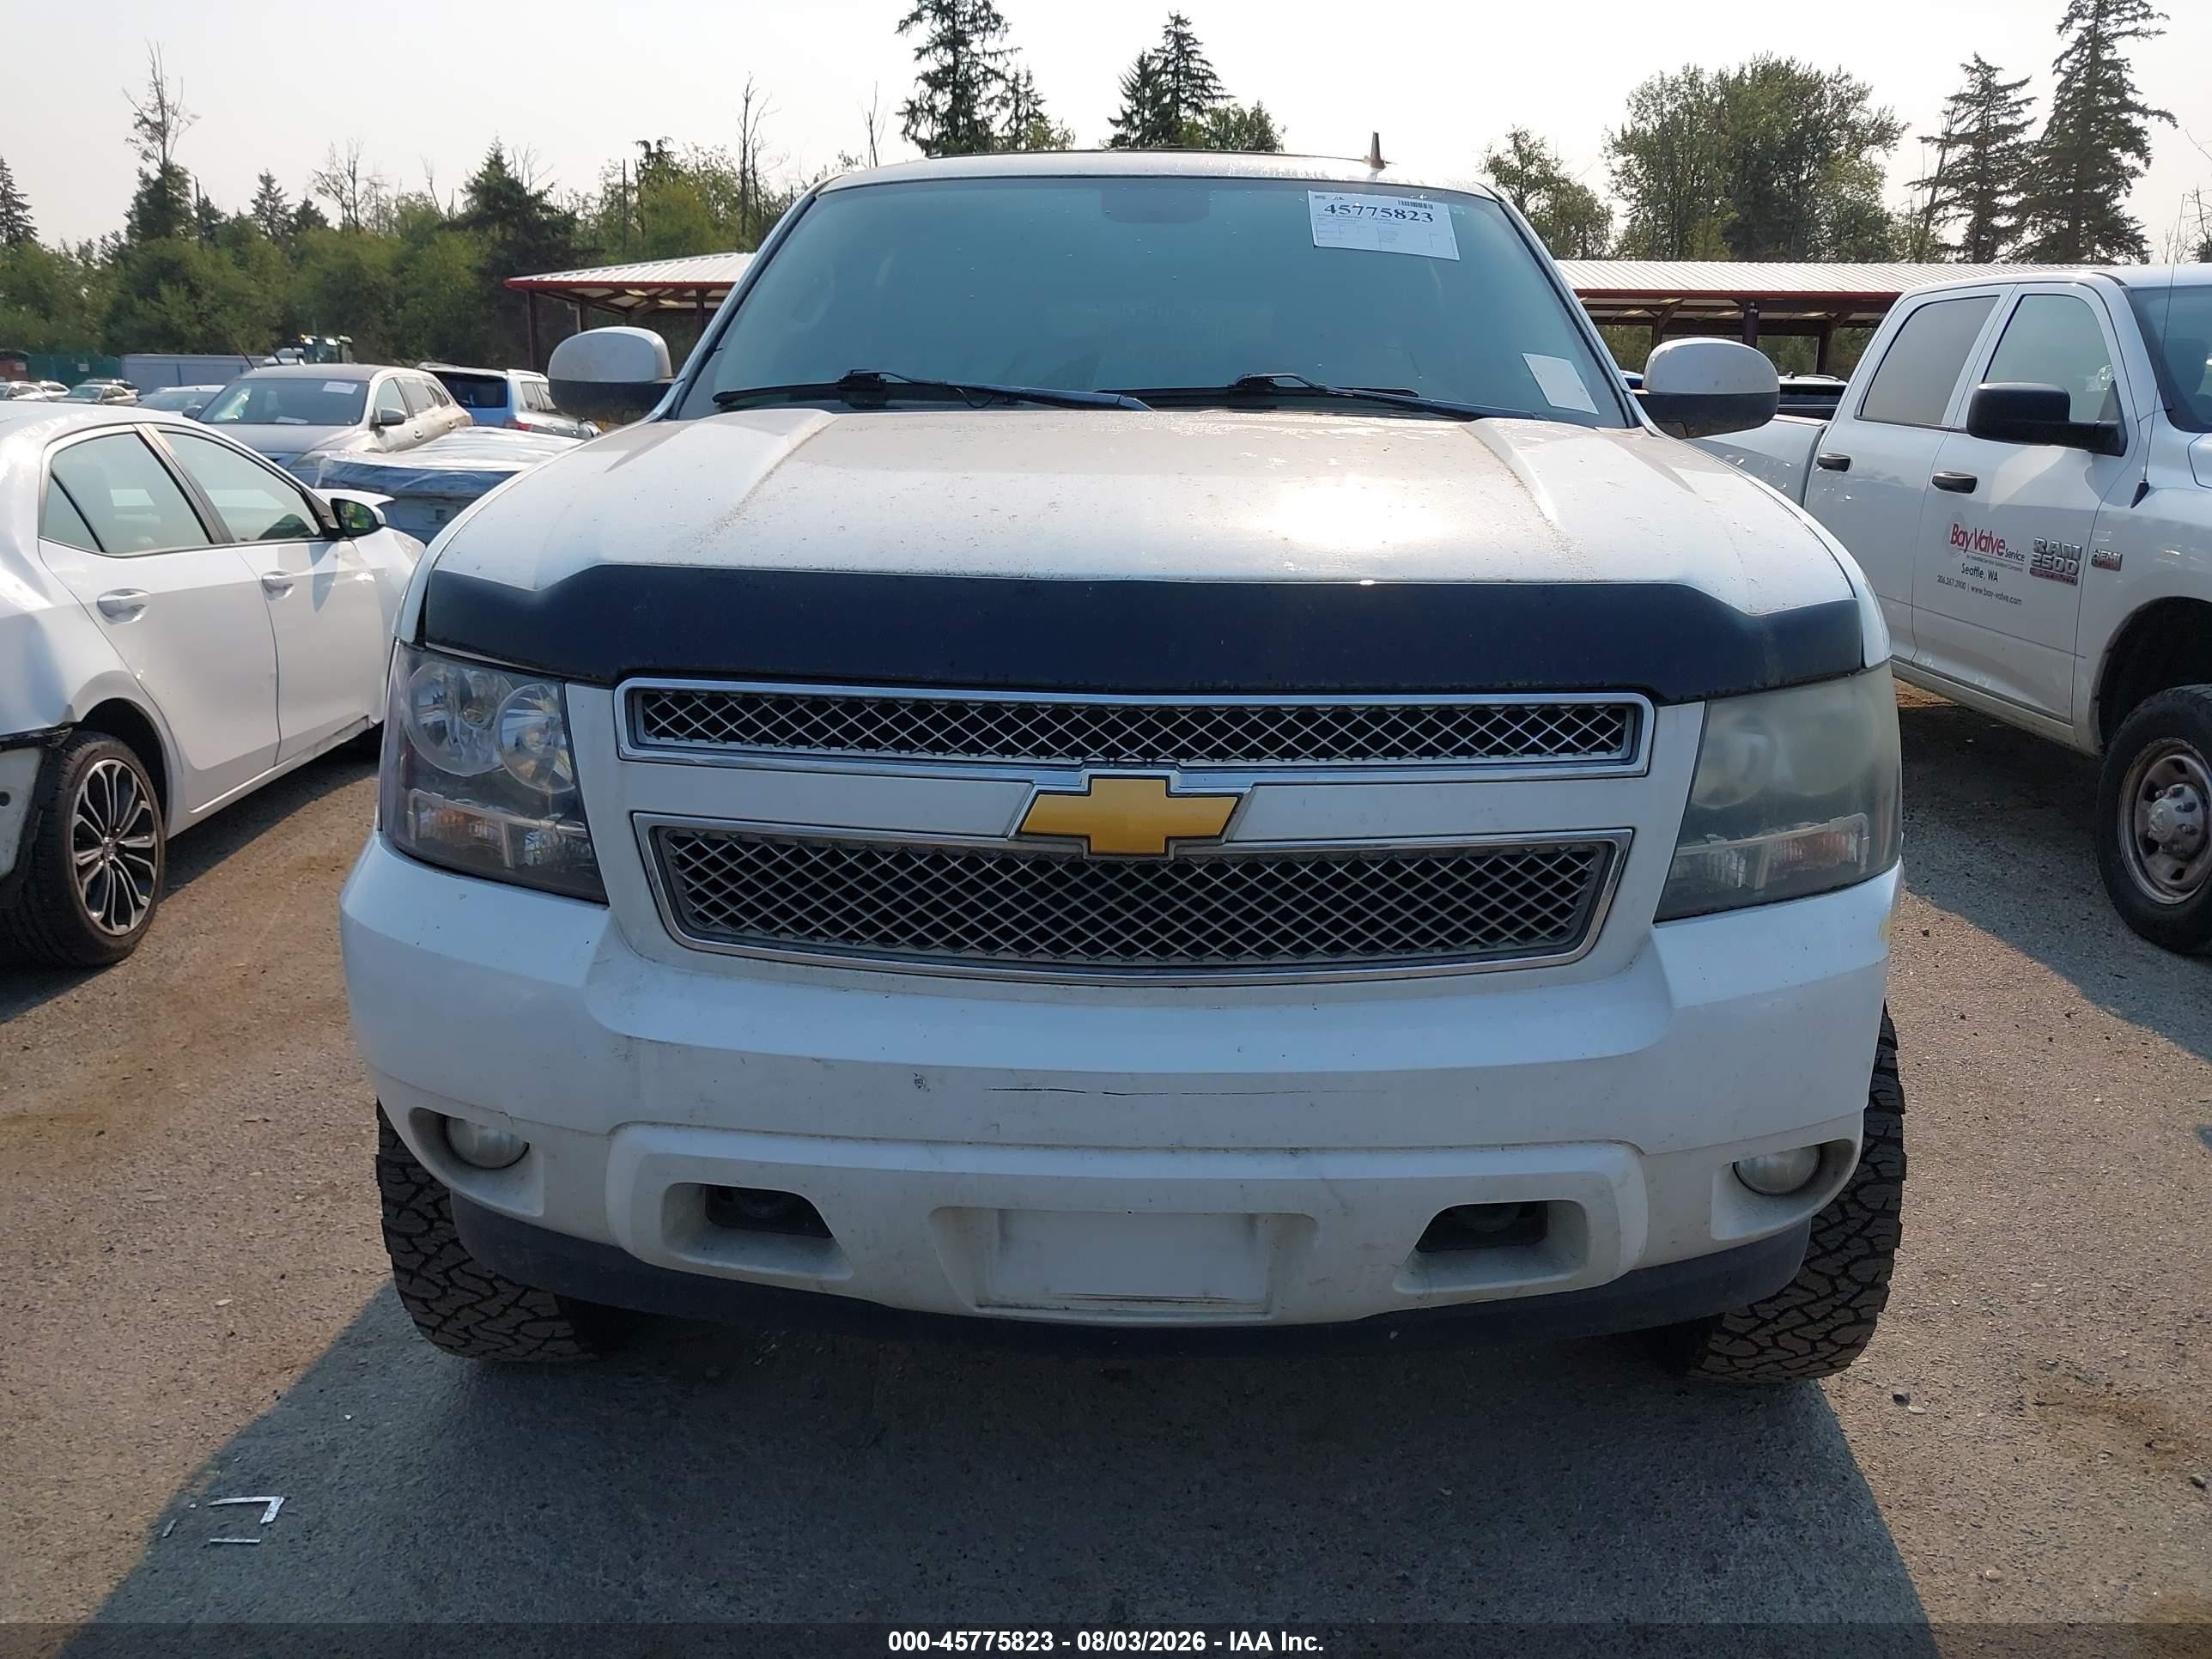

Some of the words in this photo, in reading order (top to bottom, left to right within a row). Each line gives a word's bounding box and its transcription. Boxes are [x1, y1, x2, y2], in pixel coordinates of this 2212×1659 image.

[1323, 204, 1434, 223] 45775823
[1950, 522, 1974, 553] Bay
[1974, 526, 2006, 556] Valve
[2005, 548, 2026, 562] Service
[2033, 537, 2082, 561] RAM
[1960, 562, 1985, 580] Seattle,
[1987, 569, 1999, 583] WA
[2031, 551, 2080, 576] 2500
[1971, 586, 2022, 606] www.bay-valve.com
